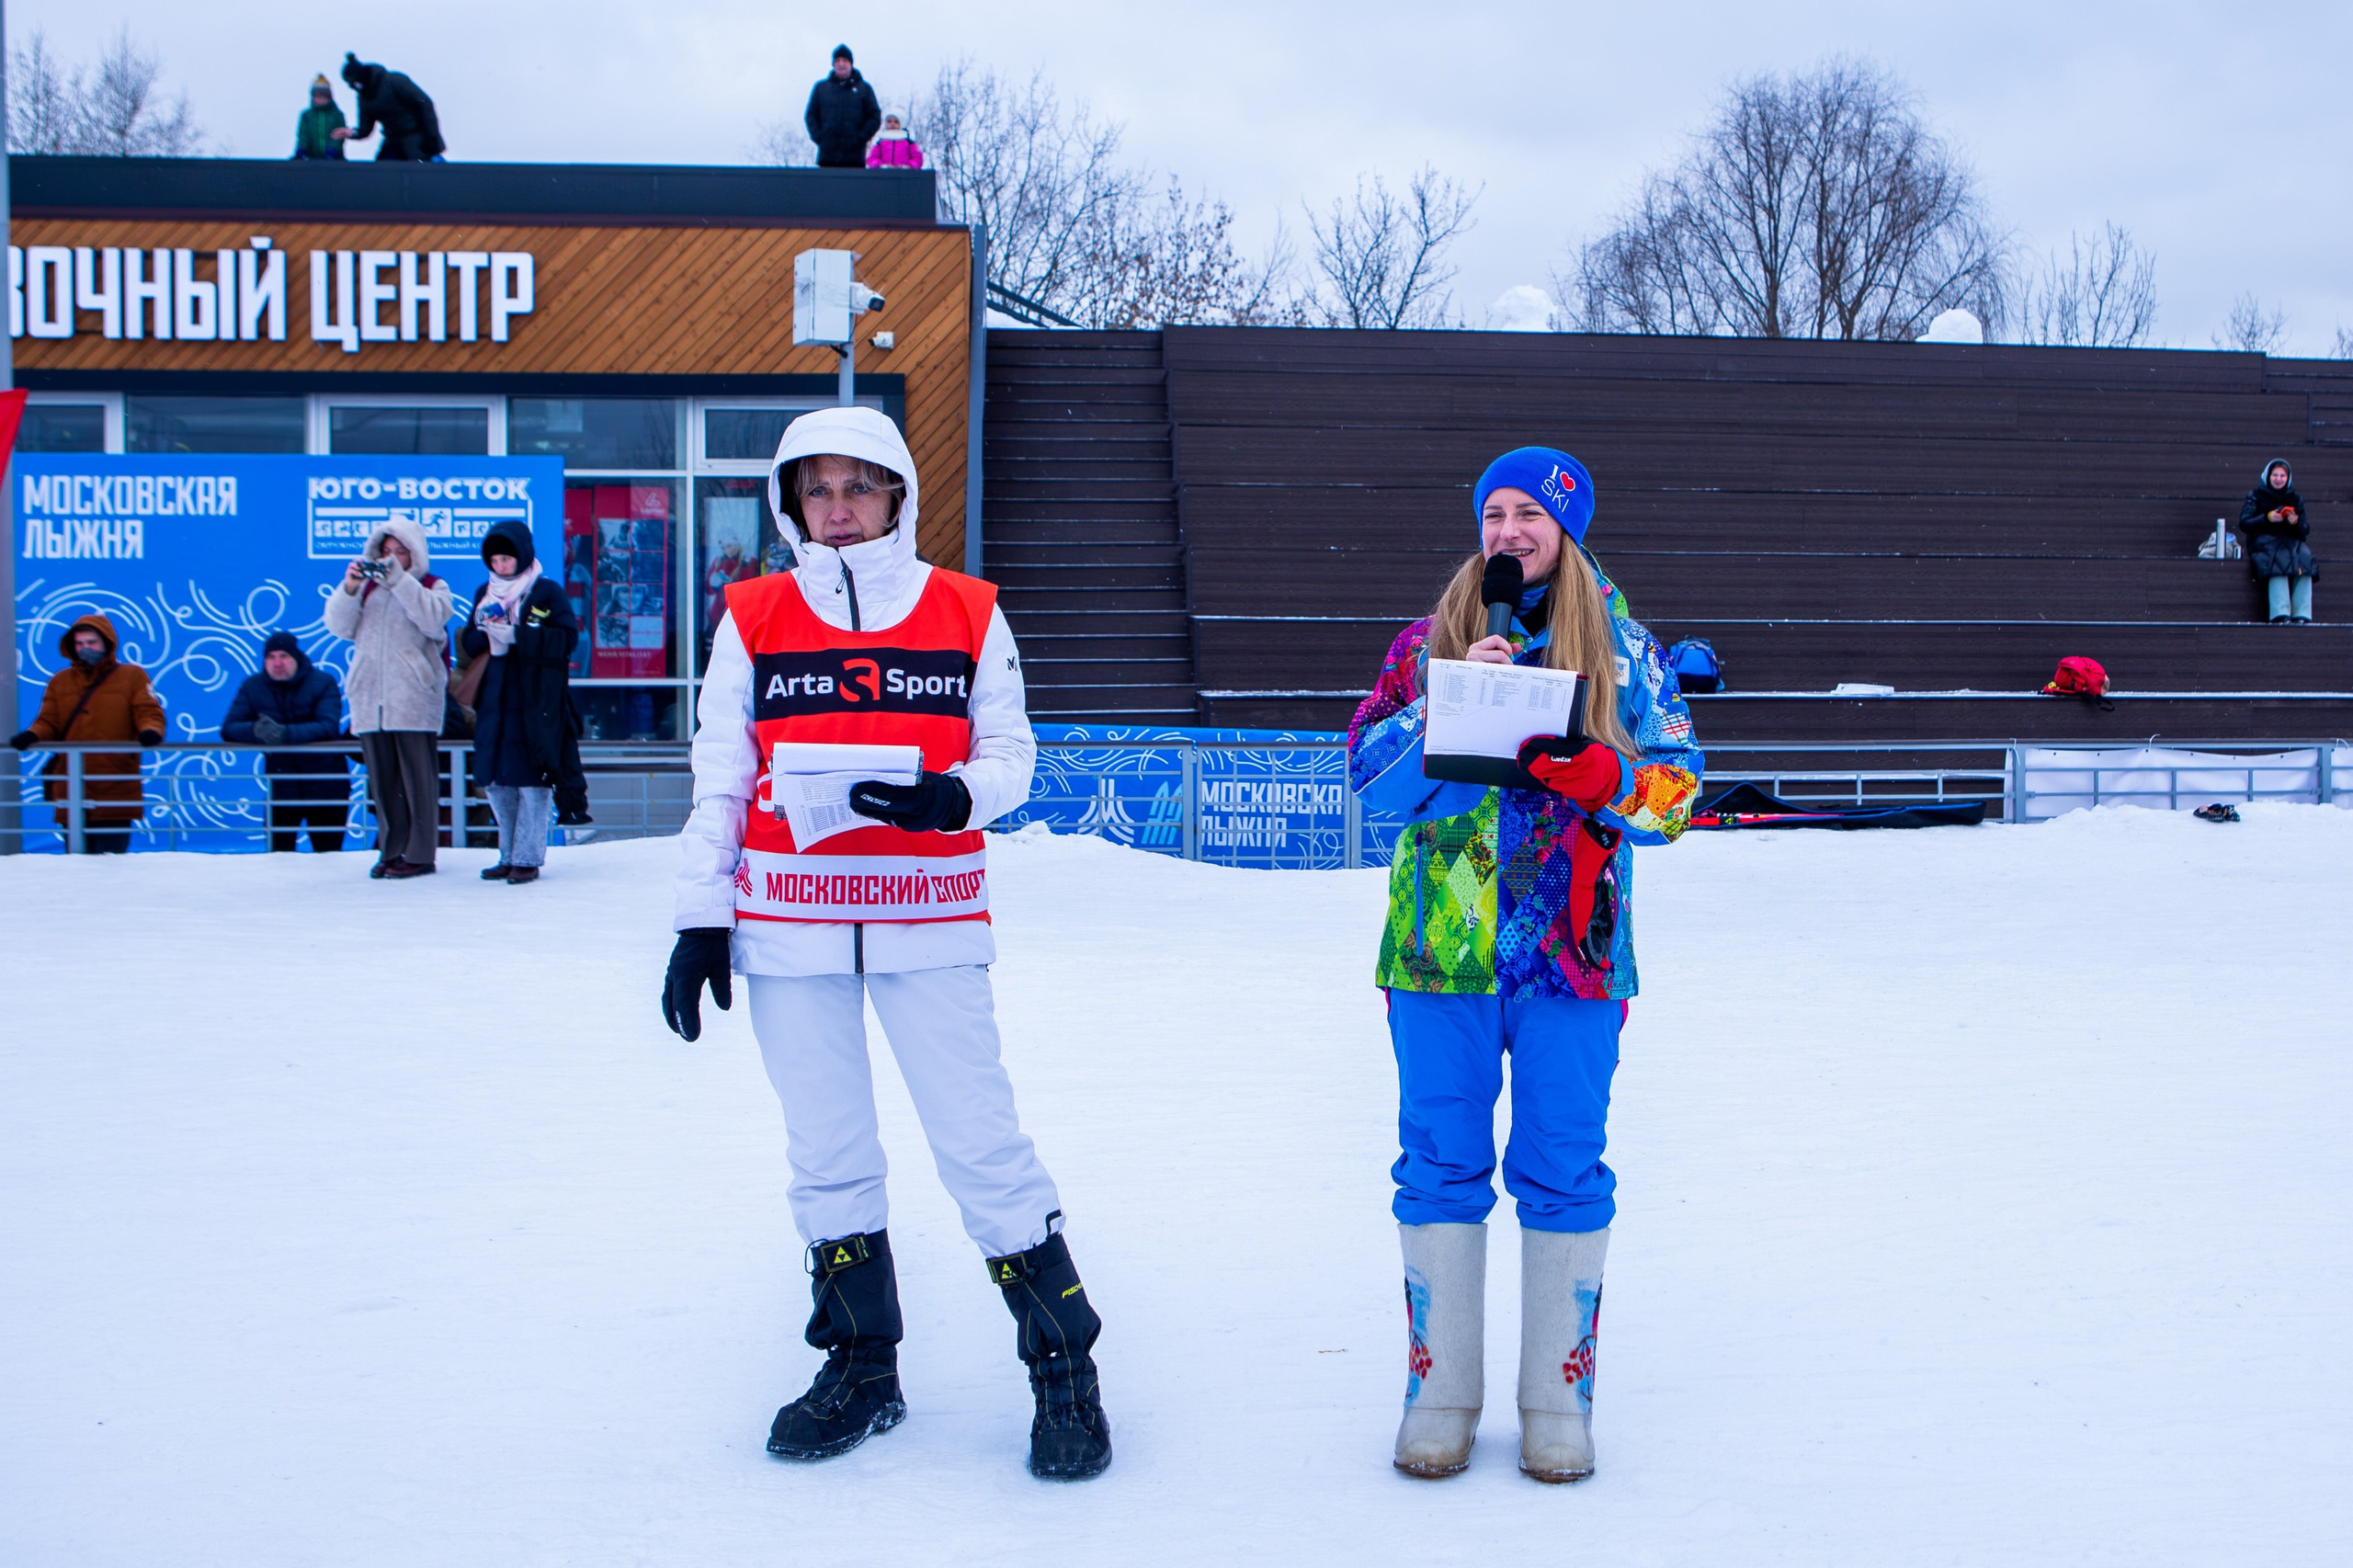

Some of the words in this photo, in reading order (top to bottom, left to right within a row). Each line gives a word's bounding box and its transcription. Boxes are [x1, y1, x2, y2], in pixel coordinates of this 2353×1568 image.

[310, 250, 535, 352] ЦЕНТР
[308, 477, 530, 501] ЮГО-ВОСТОК
[1549, 464, 1559, 481] I
[23, 474, 238, 516] МОСКОВСКАЯ
[1540, 478, 1569, 513] SKI
[23, 518, 144, 560] ЛЫЖНЯ
[765, 673, 834, 699] Arta
[886, 668, 967, 700] Sport
[1201, 781, 1345, 815] МОСКОВСКА
[1201, 815, 1287, 847] ЛЫЖНЯ
[766, 869, 929, 905] МОСКОВСКИЙ
